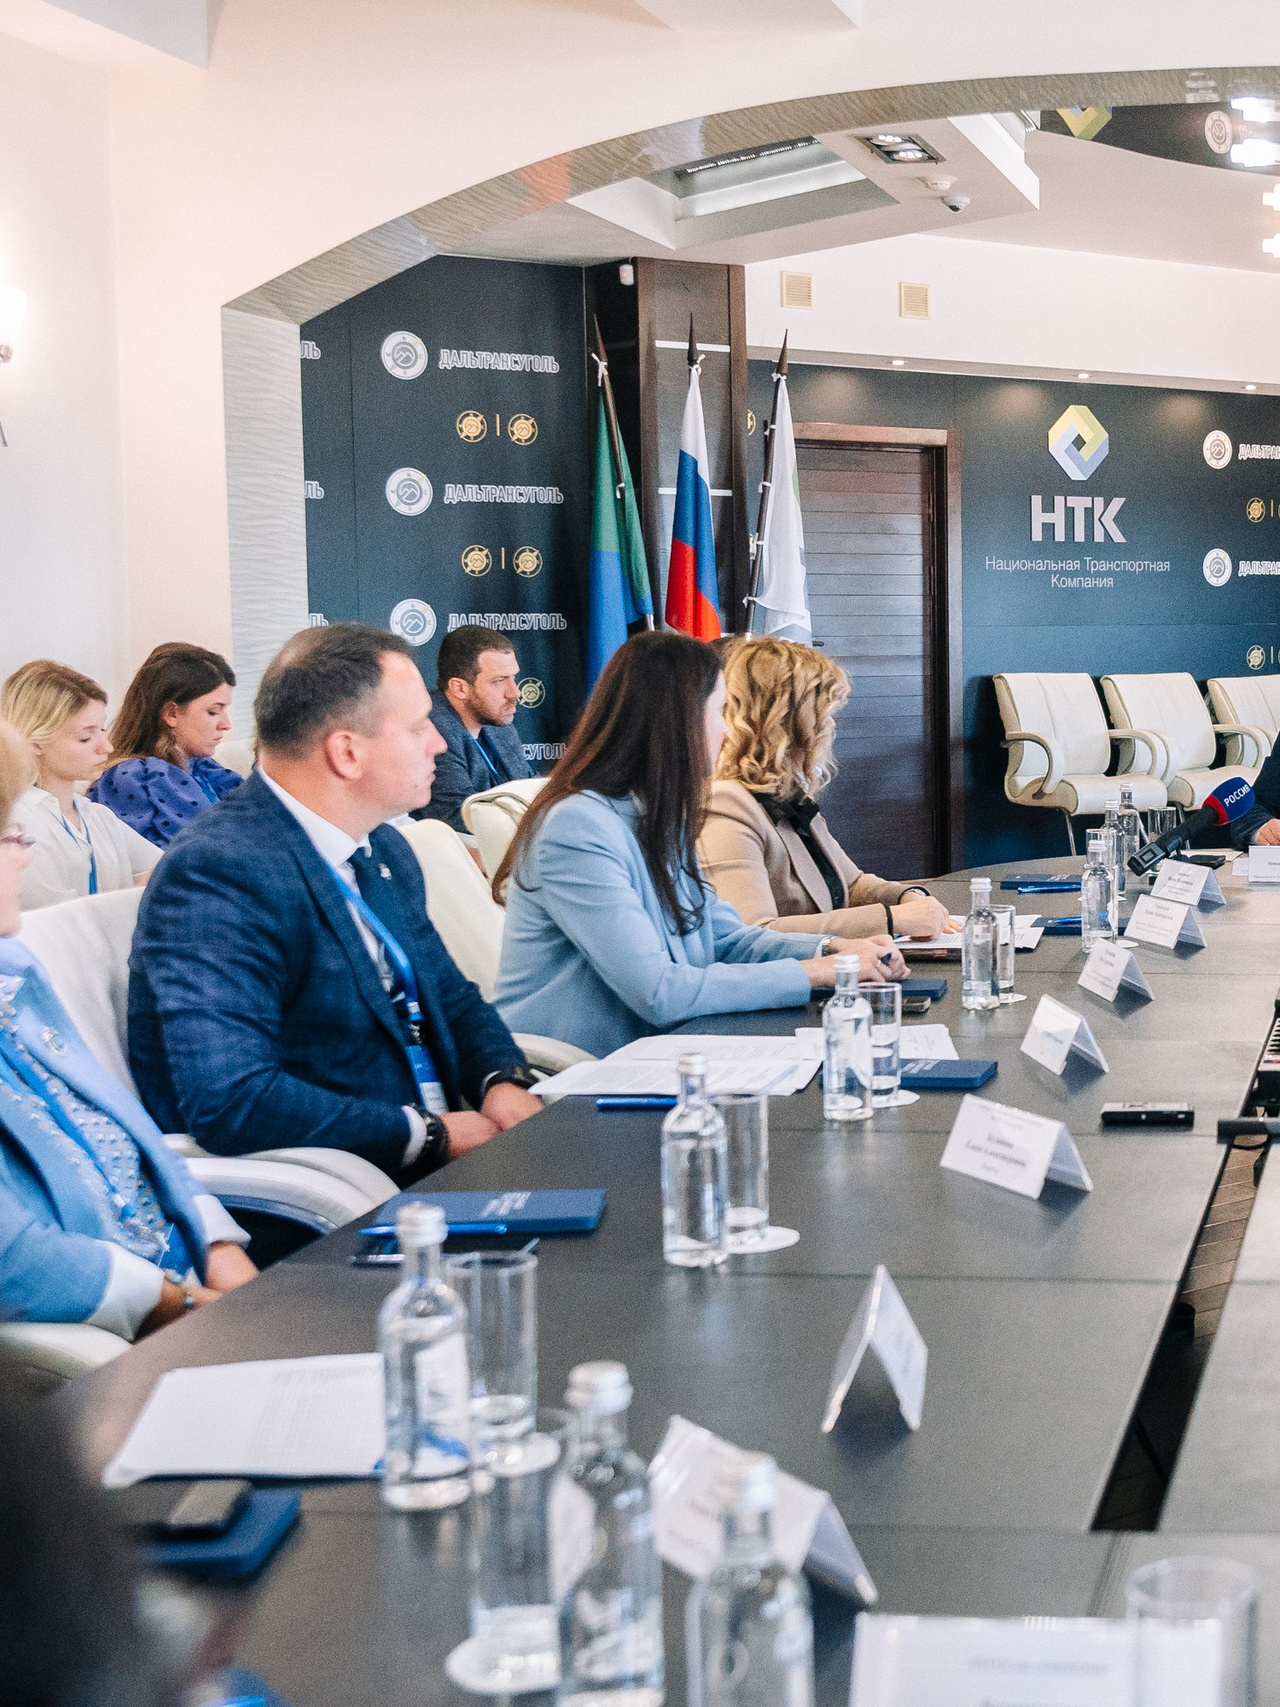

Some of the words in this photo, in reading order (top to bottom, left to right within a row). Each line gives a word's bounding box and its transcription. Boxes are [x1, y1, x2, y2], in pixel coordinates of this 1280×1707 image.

[438, 349, 560, 373] ДАЛЬТРАНСУГОЛЬ
[443, 483, 564, 504] ДАЛЬТРАНСУГОЛЬ
[1031, 494, 1127, 543] НТК
[985, 556, 1080, 572] Национальная
[1083, 556, 1171, 574] Транспортная
[1051, 573, 1114, 588] Компания
[1223, 784, 1251, 807] РОССИЯ
